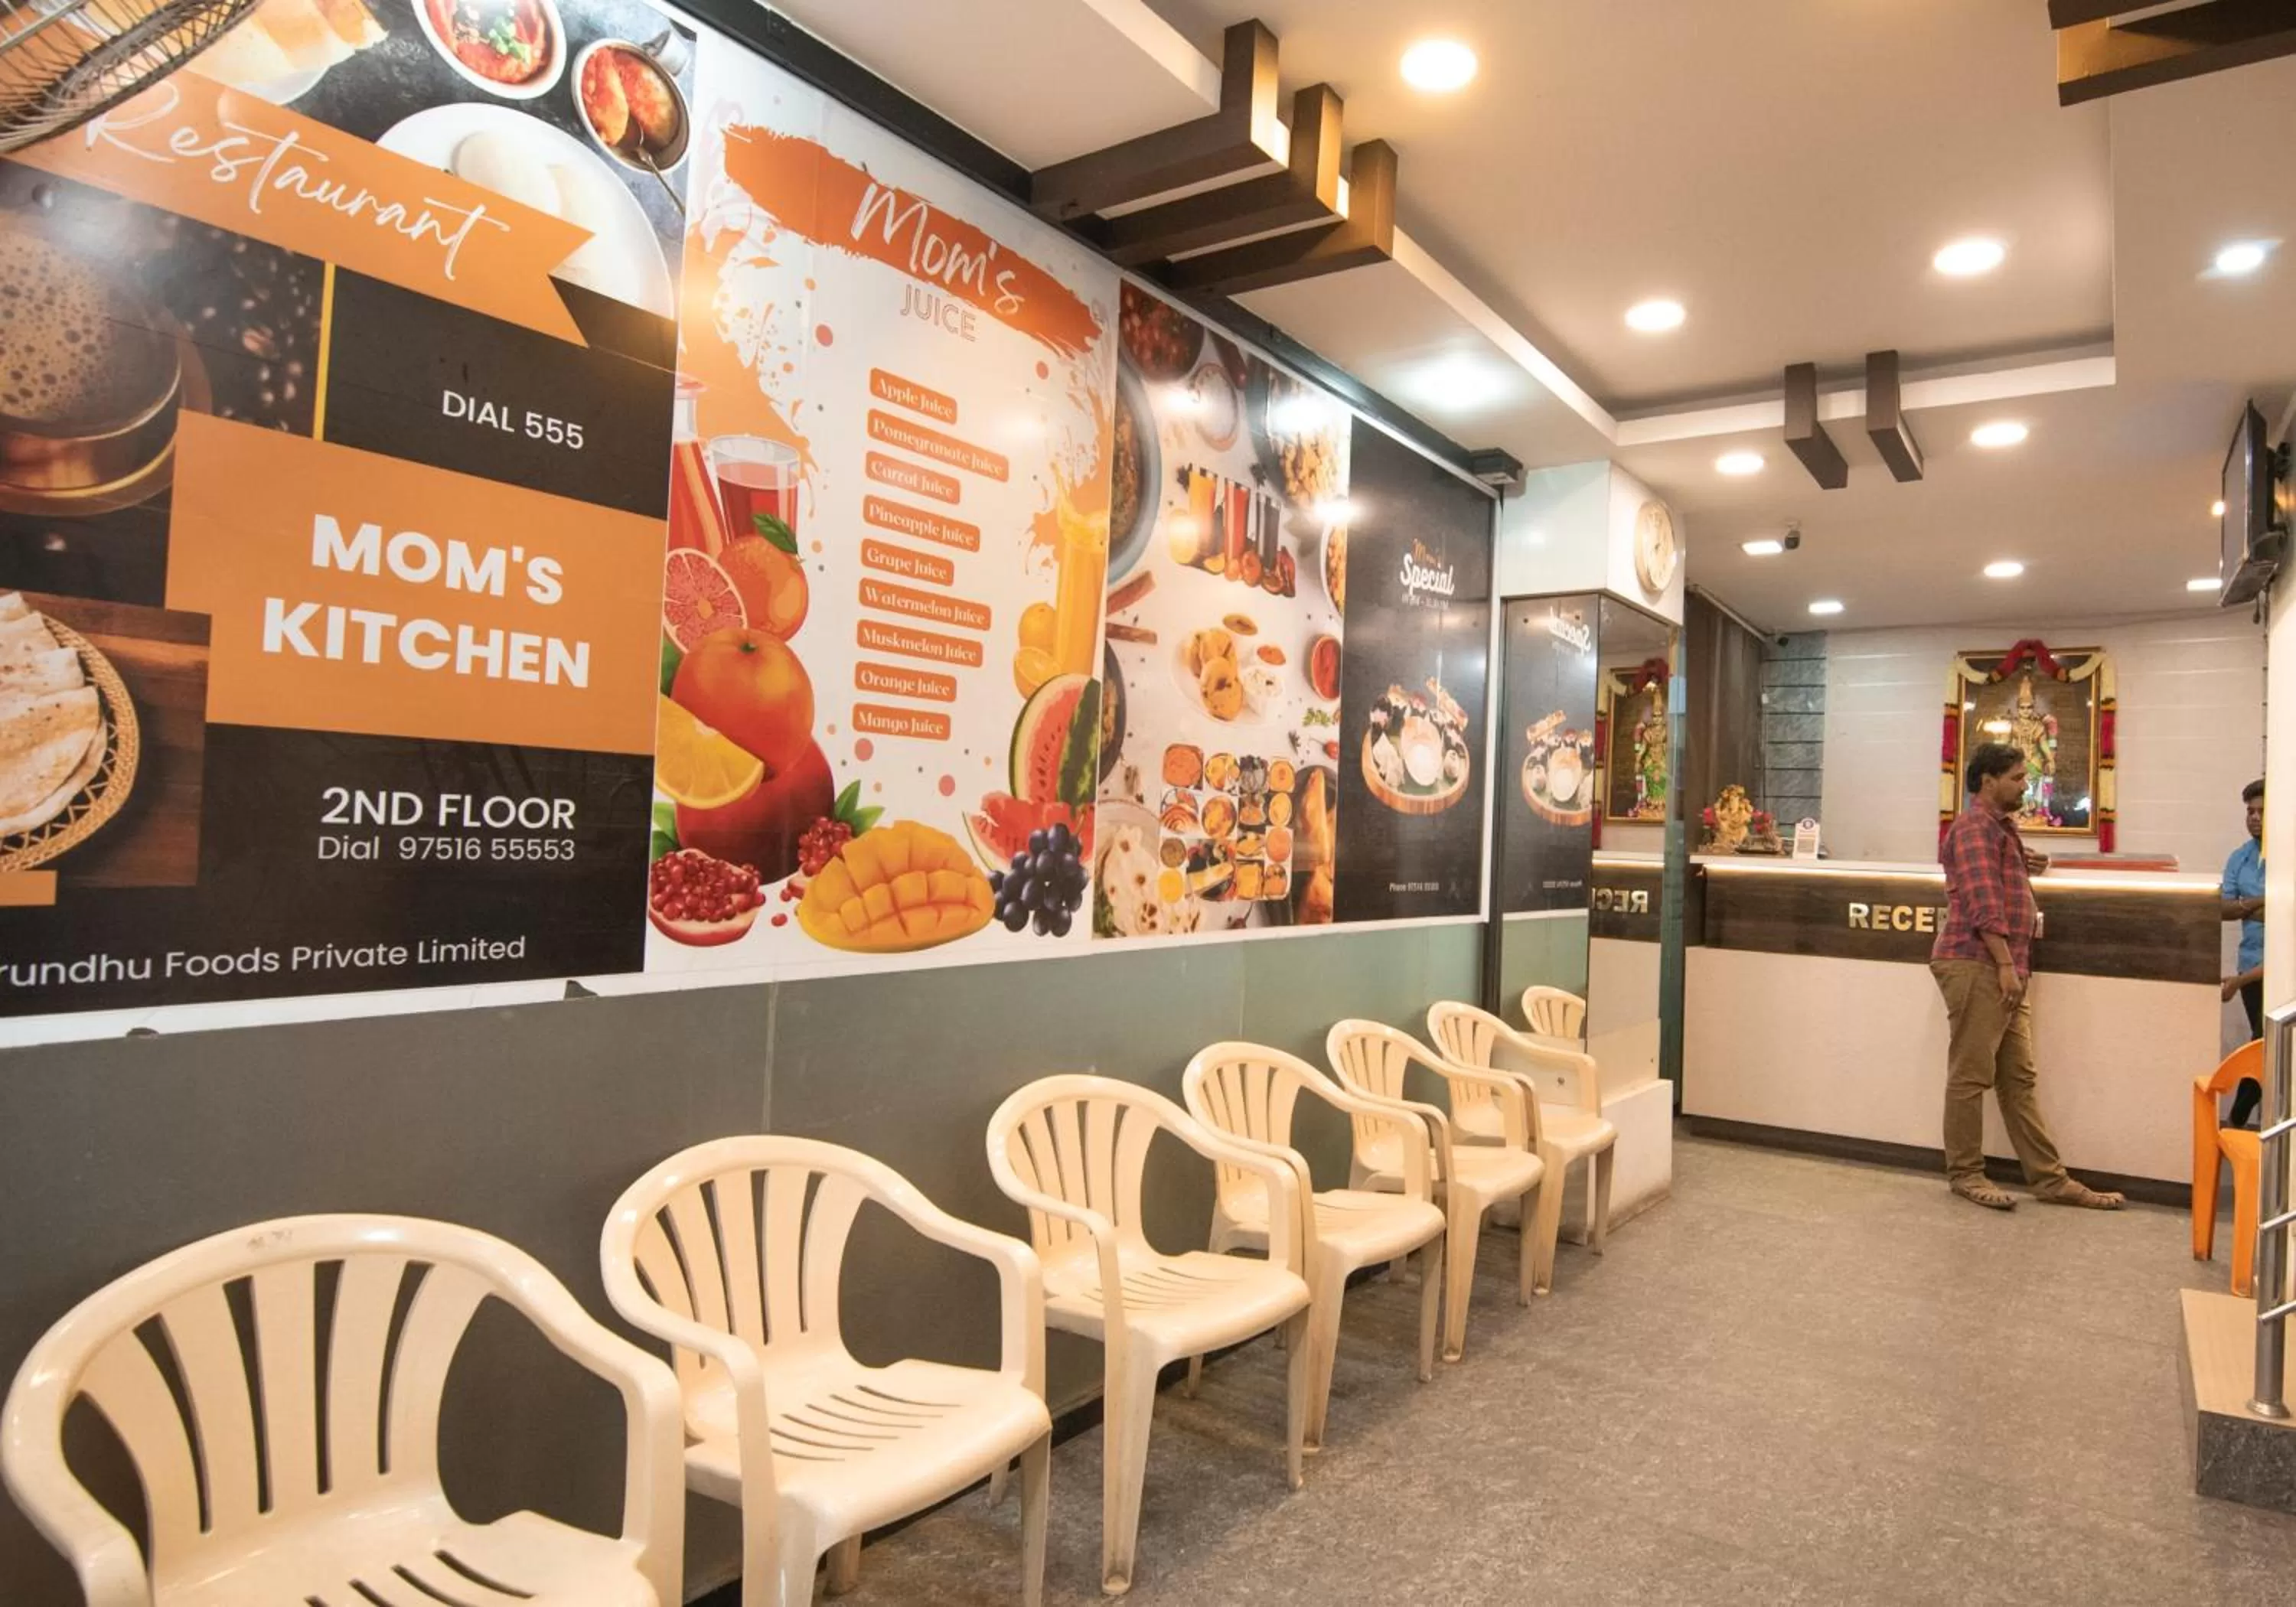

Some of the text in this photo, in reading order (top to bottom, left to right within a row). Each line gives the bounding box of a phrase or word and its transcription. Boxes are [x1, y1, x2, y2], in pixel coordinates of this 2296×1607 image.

[86, 80, 511, 281] Restaurant
[850, 183, 1025, 315] Mom's
[899, 283, 977, 342] JUICE
[878, 379, 954, 418] Apple Juice
[442, 390, 584, 449] DIAL 555
[971, 453, 1004, 475] Juice
[921, 476, 954, 497] Juice
[869, 503, 975, 546] Pineapple Juice
[867, 548, 947, 579] Grape Juice
[1400, 553, 1454, 596] Special
[866, 585, 986, 625] Watermelon Juice
[263, 597, 590, 688] KITCHEN
[862, 627, 977, 663] Muskmelon Juice
[860, 670, 951, 696] Orange Juice
[859, 711, 944, 735] Mango Juice
[321, 787, 576, 829] 2ND FLOOR
[318, 836, 576, 861] Dial 97516 55553
[165, 946, 280, 978] Foods
[291, 940, 408, 971] Private
[419, 936, 526, 965] Limited
